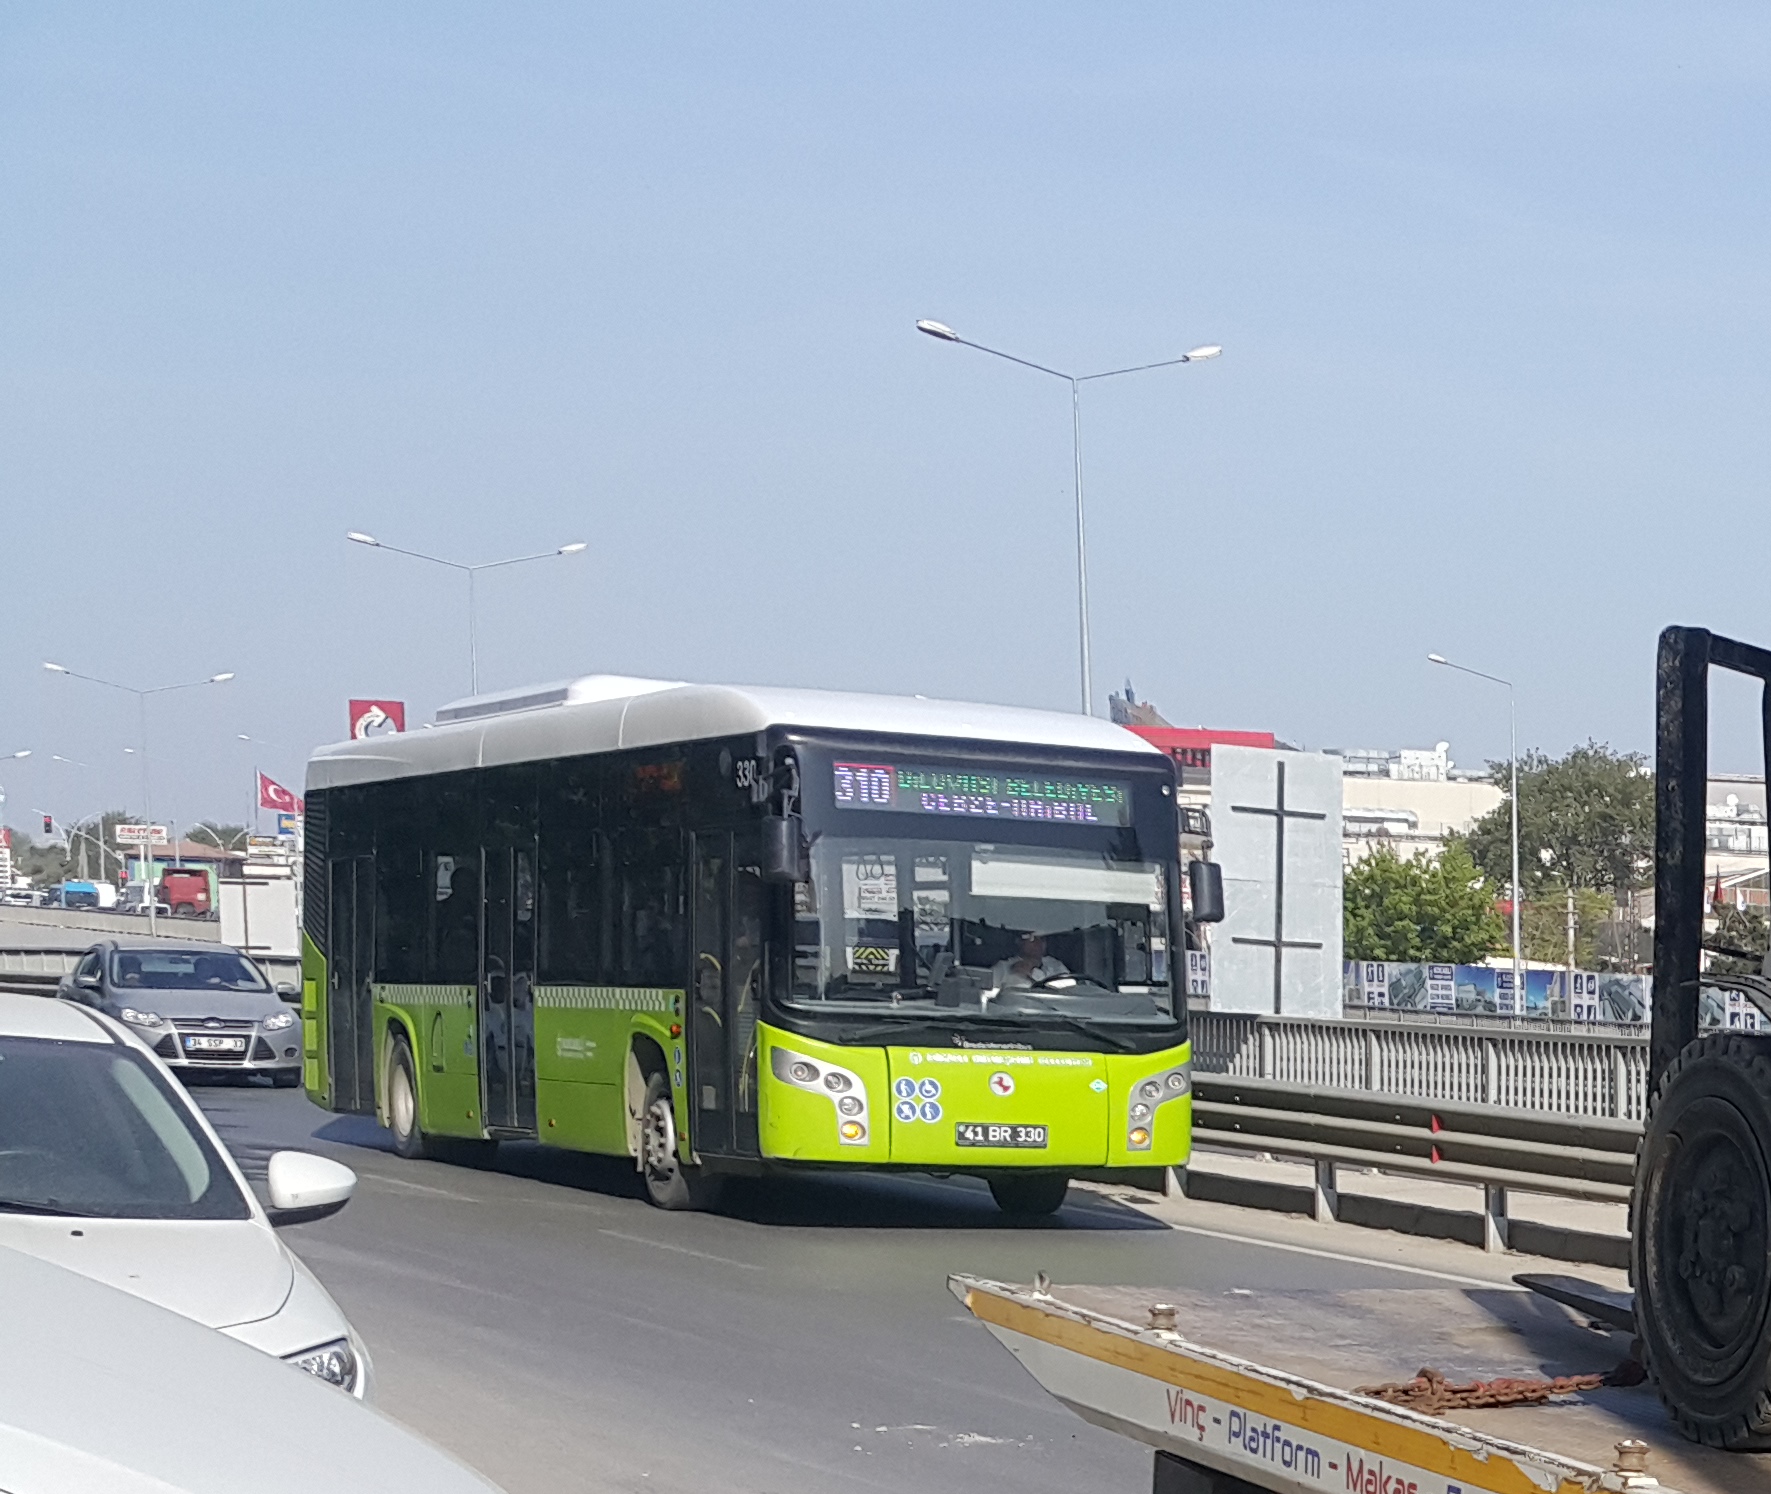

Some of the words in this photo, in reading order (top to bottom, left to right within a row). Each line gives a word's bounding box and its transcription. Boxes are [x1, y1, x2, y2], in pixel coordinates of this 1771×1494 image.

[834, 767, 890, 804] 310
[963, 1126, 984, 1141] 41
[988, 1126, 1011, 1141] BR
[1016, 1127, 1044, 1142] 330
[1166, 1388, 1207, 1441] Vinç
[1228, 1409, 1321, 1479] Platform
